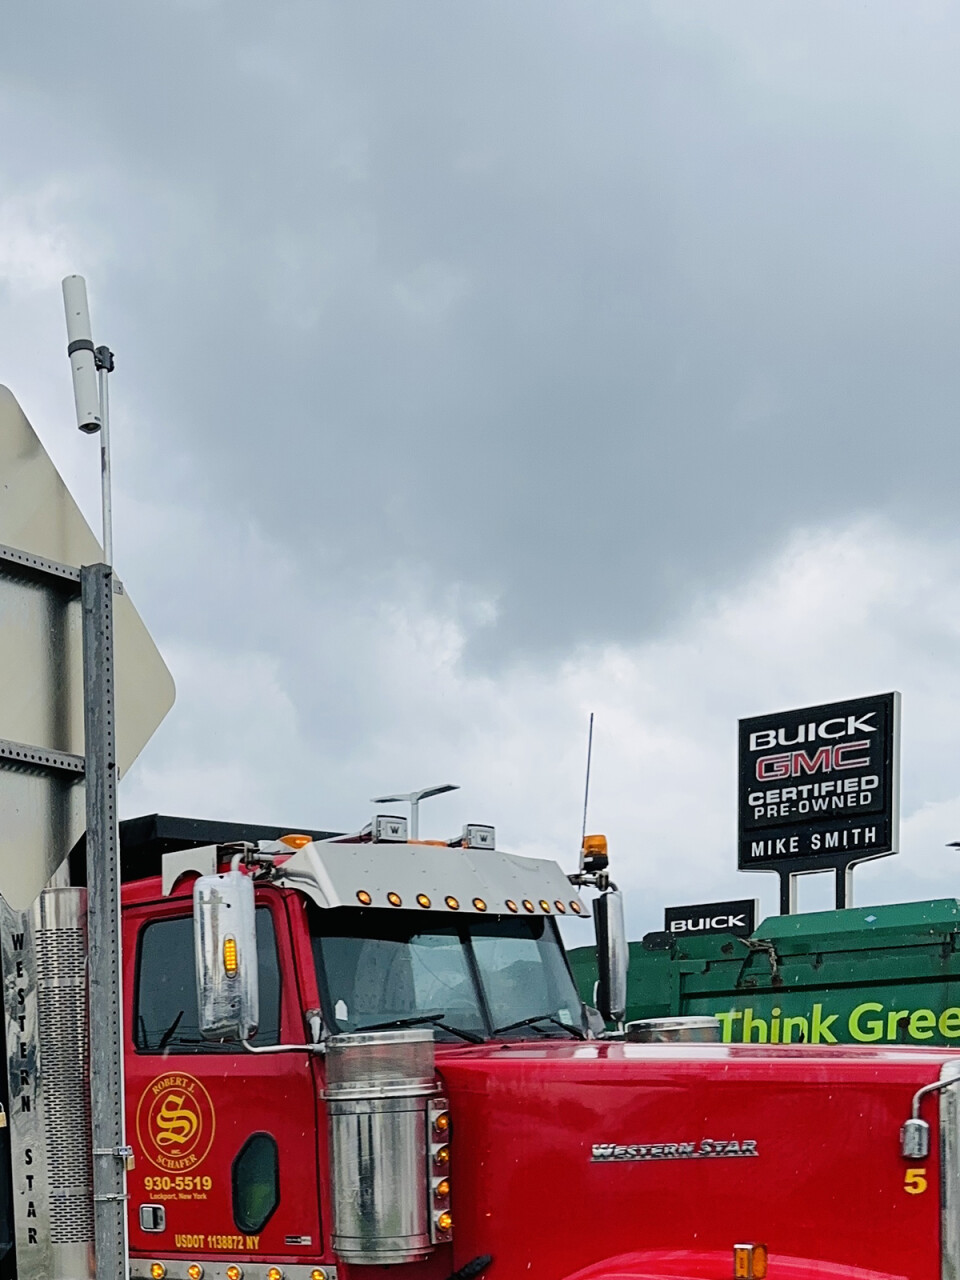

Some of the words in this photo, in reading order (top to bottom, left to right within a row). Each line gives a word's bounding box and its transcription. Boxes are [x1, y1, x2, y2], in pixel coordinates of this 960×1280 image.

[749, 711, 878, 752] BUICK
[755, 739, 871, 782] GMC
[748, 775, 879, 806] CERTIFIED
[754, 791, 872, 820] PRE-OWNED
[751, 836, 800, 857] MIKE
[811, 826, 876, 850] SMITH
[670, 914, 746, 933] BUICK
[714, 1003, 840, 1044] Think
[12, 933, 32, 1114] WESTERN
[24, 1148, 38, 1245] STAR
[152, 1076, 189, 1095] ROBERT
[156, 1094, 198, 1146] S
[156, 1153, 198, 1169] SCHAFER
[591, 1143, 696, 1160] WESTERN
[698, 1138, 758, 1156] STAR
[144, 1176, 212, 1190] 930-5519
[903, 1168, 928, 1194] 5
[178, 1192, 192, 1200] New
[192, 1192, 208, 1200] York
[175, 1234, 205, 1247] USDOT
[207, 1235, 244, 1249] 1138872
[246, 1236, 260, 1250] NY
